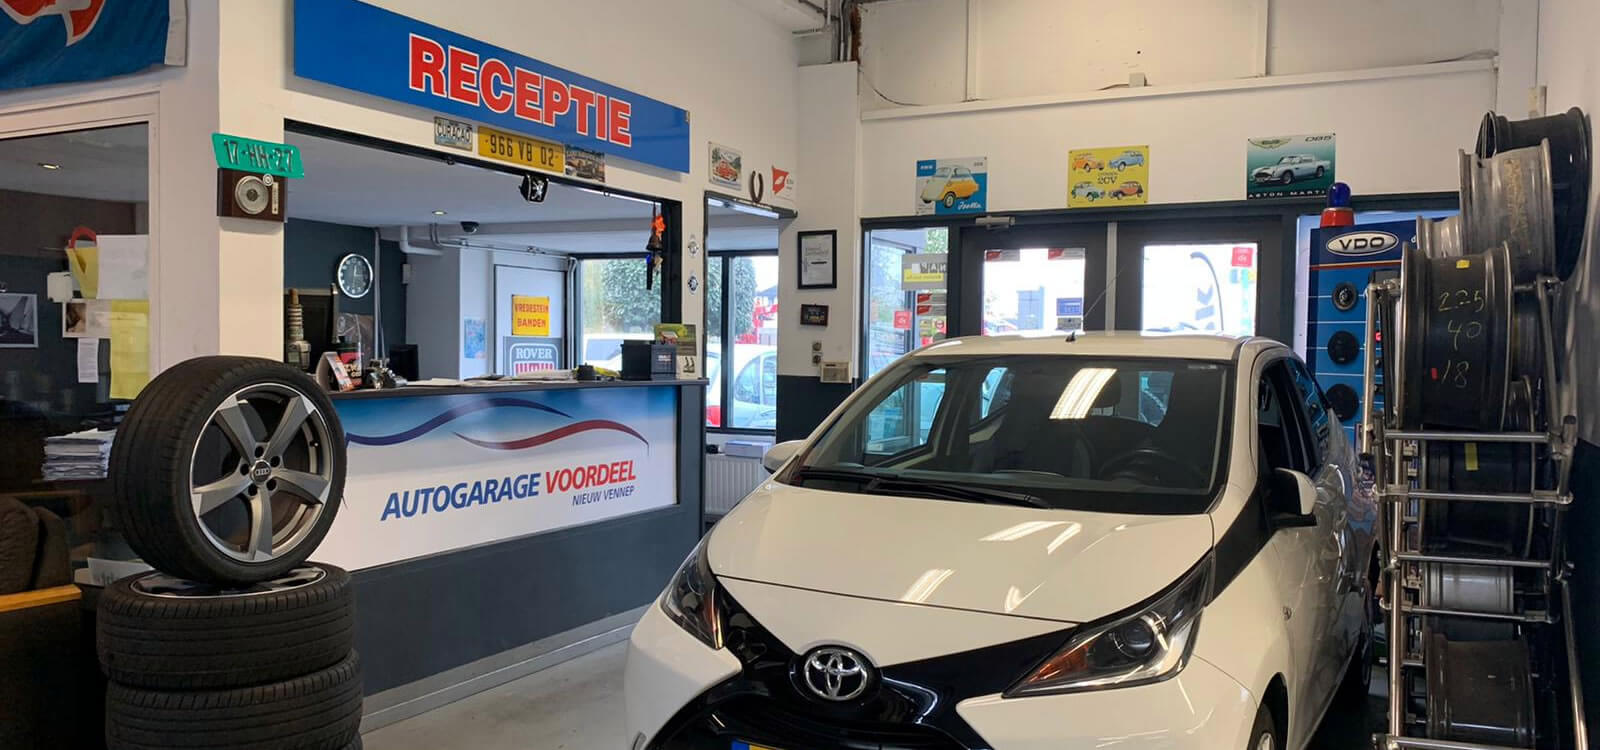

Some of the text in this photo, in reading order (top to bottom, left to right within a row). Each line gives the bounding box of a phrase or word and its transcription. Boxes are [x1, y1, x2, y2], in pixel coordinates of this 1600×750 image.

[408, 32, 632, 148] RECEPTIE
[490, 134, 513, 158] 966
[518, 140, 533, 162] VB
[540, 146, 555, 167] 02
[1248, 189, 1326, 199] ASTON MARTI
[1338, 236, 1385, 250] VDO
[515, 303, 549, 313] VREDESTEIN
[517, 318, 546, 328] BANDEN
[1447, 319, 1482, 352] 40
[515, 347, 553, 360] ROVER
[1441, 360, 1470, 388] 18
[380, 459, 637, 521] AUTOGARAGE VOORDEEL
[571, 485, 636, 507] NIEUW VENNEP
